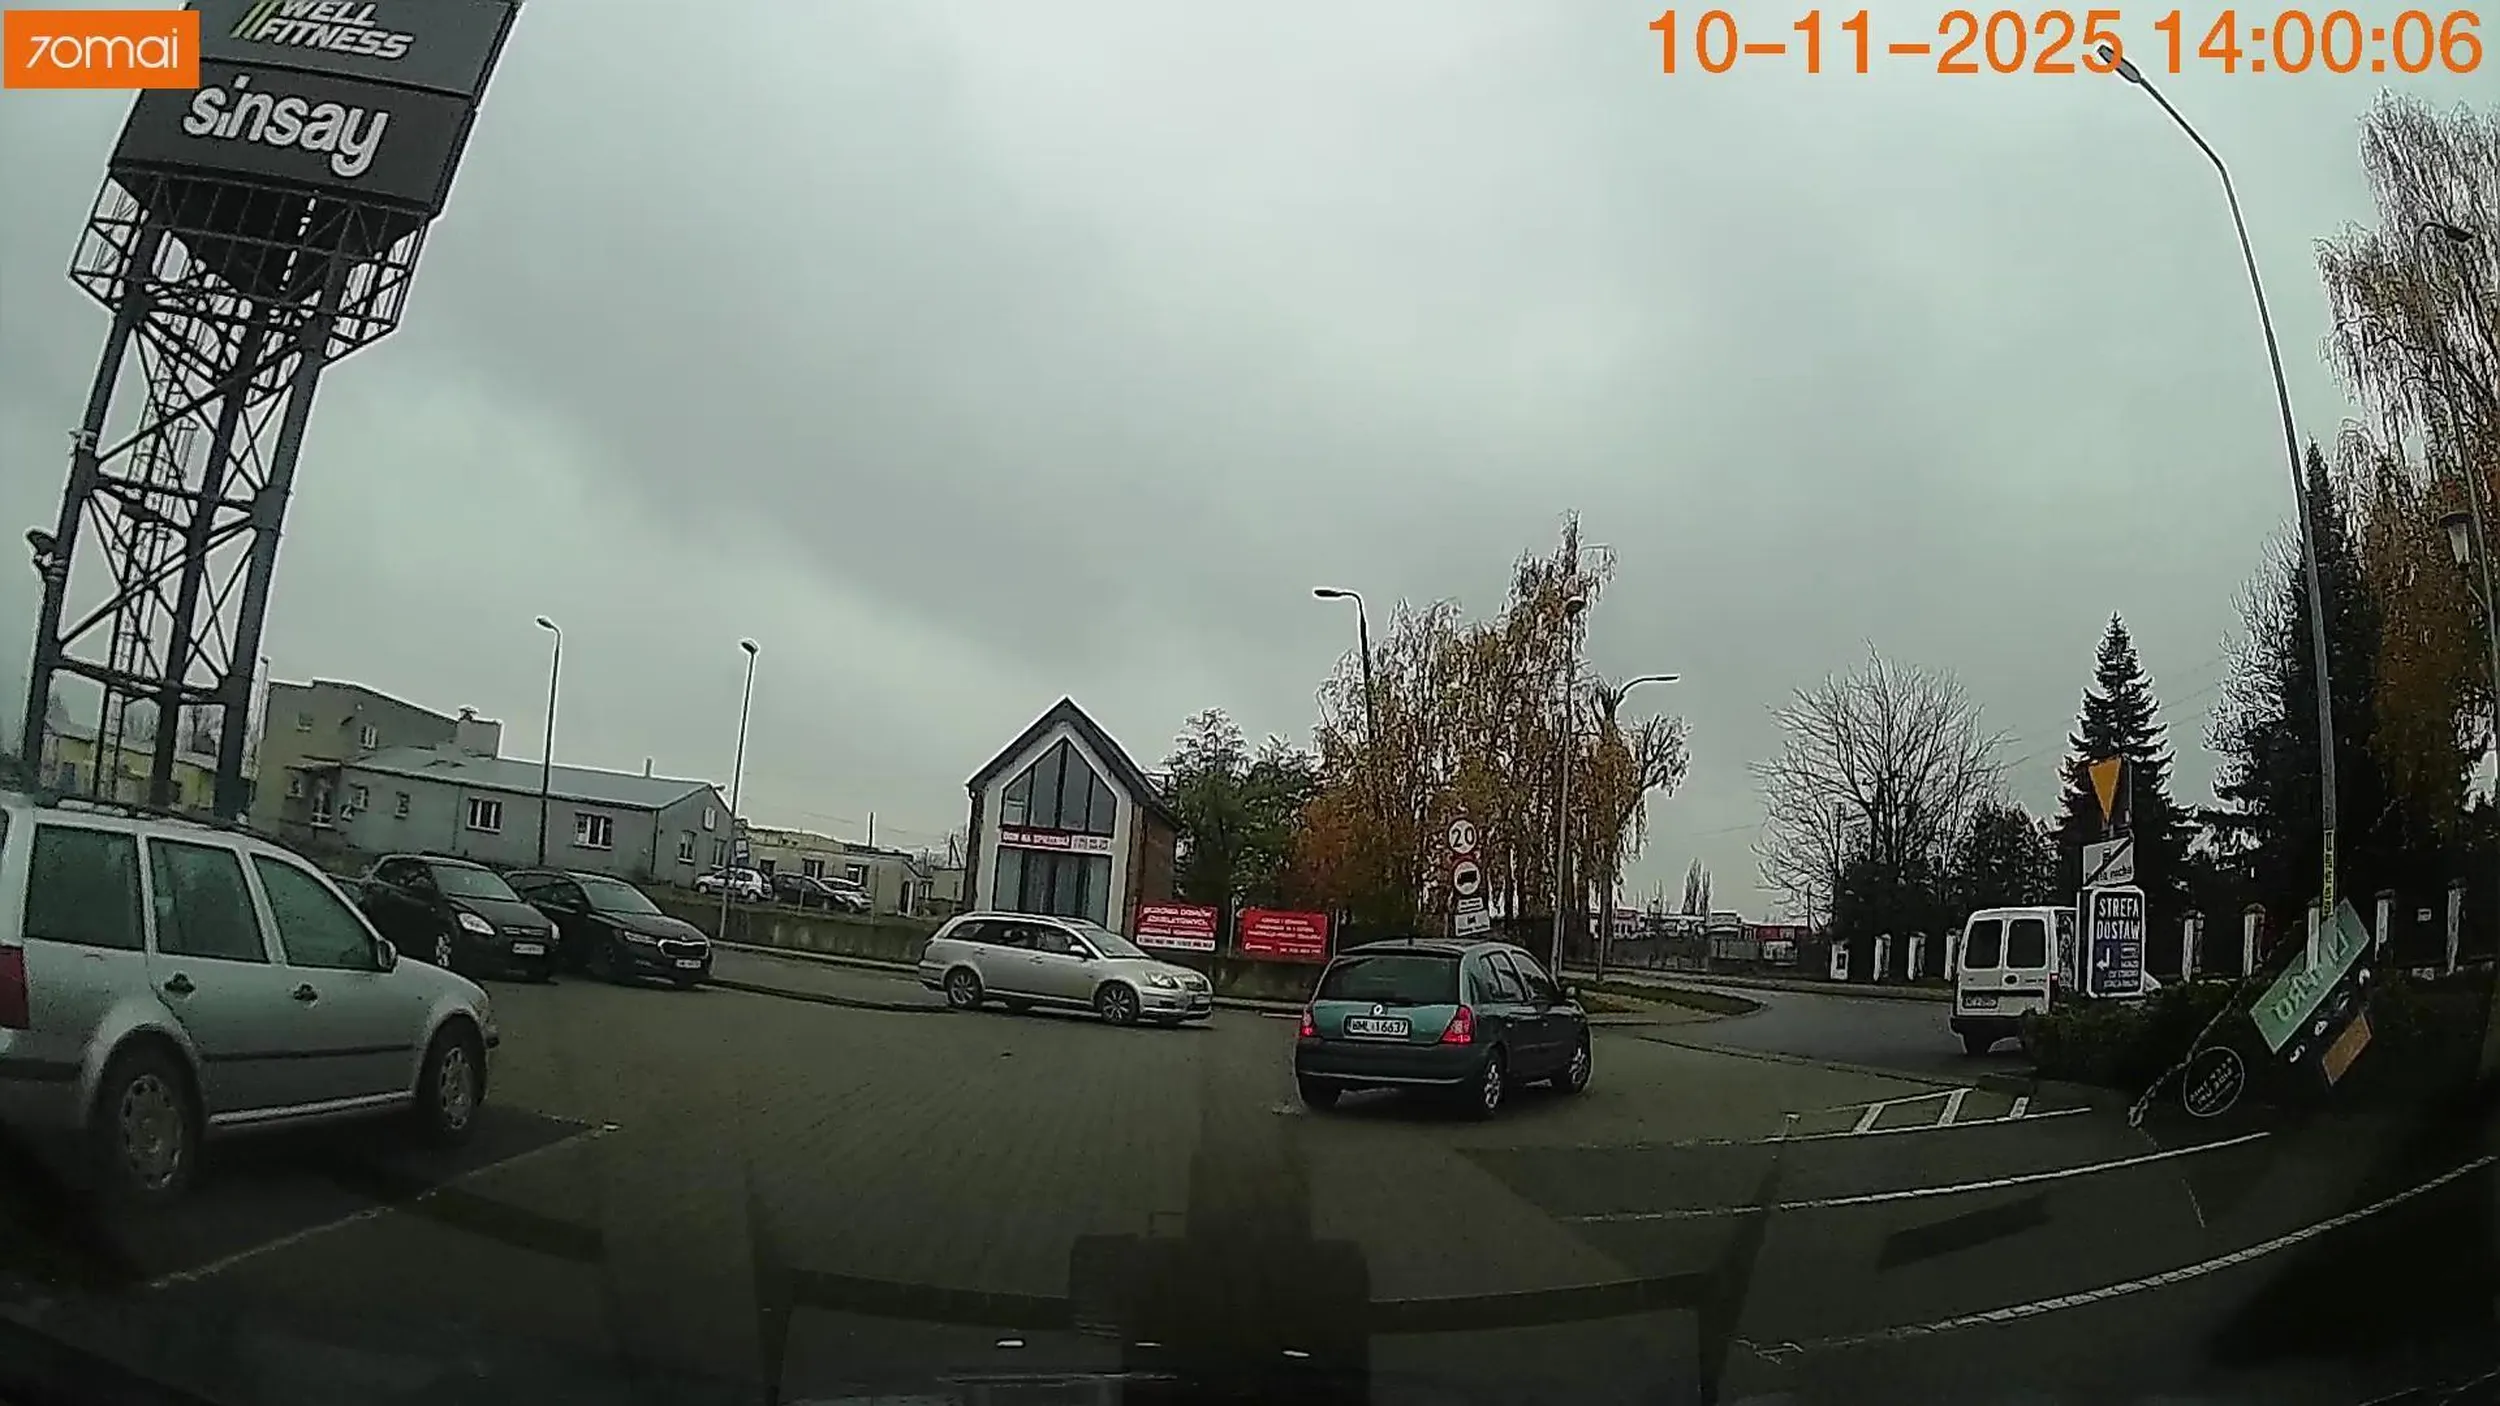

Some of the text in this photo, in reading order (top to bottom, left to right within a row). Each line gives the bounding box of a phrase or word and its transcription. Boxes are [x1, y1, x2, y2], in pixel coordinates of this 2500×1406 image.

[279, 0, 377, 27] WELL
[252, 18, 415, 59] FITNESS
[182, 74, 390, 178] sinsay
[1451, 827, 1475, 848] 20
[2099, 897, 2139, 918] STREFA
[2096, 919, 2141, 941] DOSTAW
